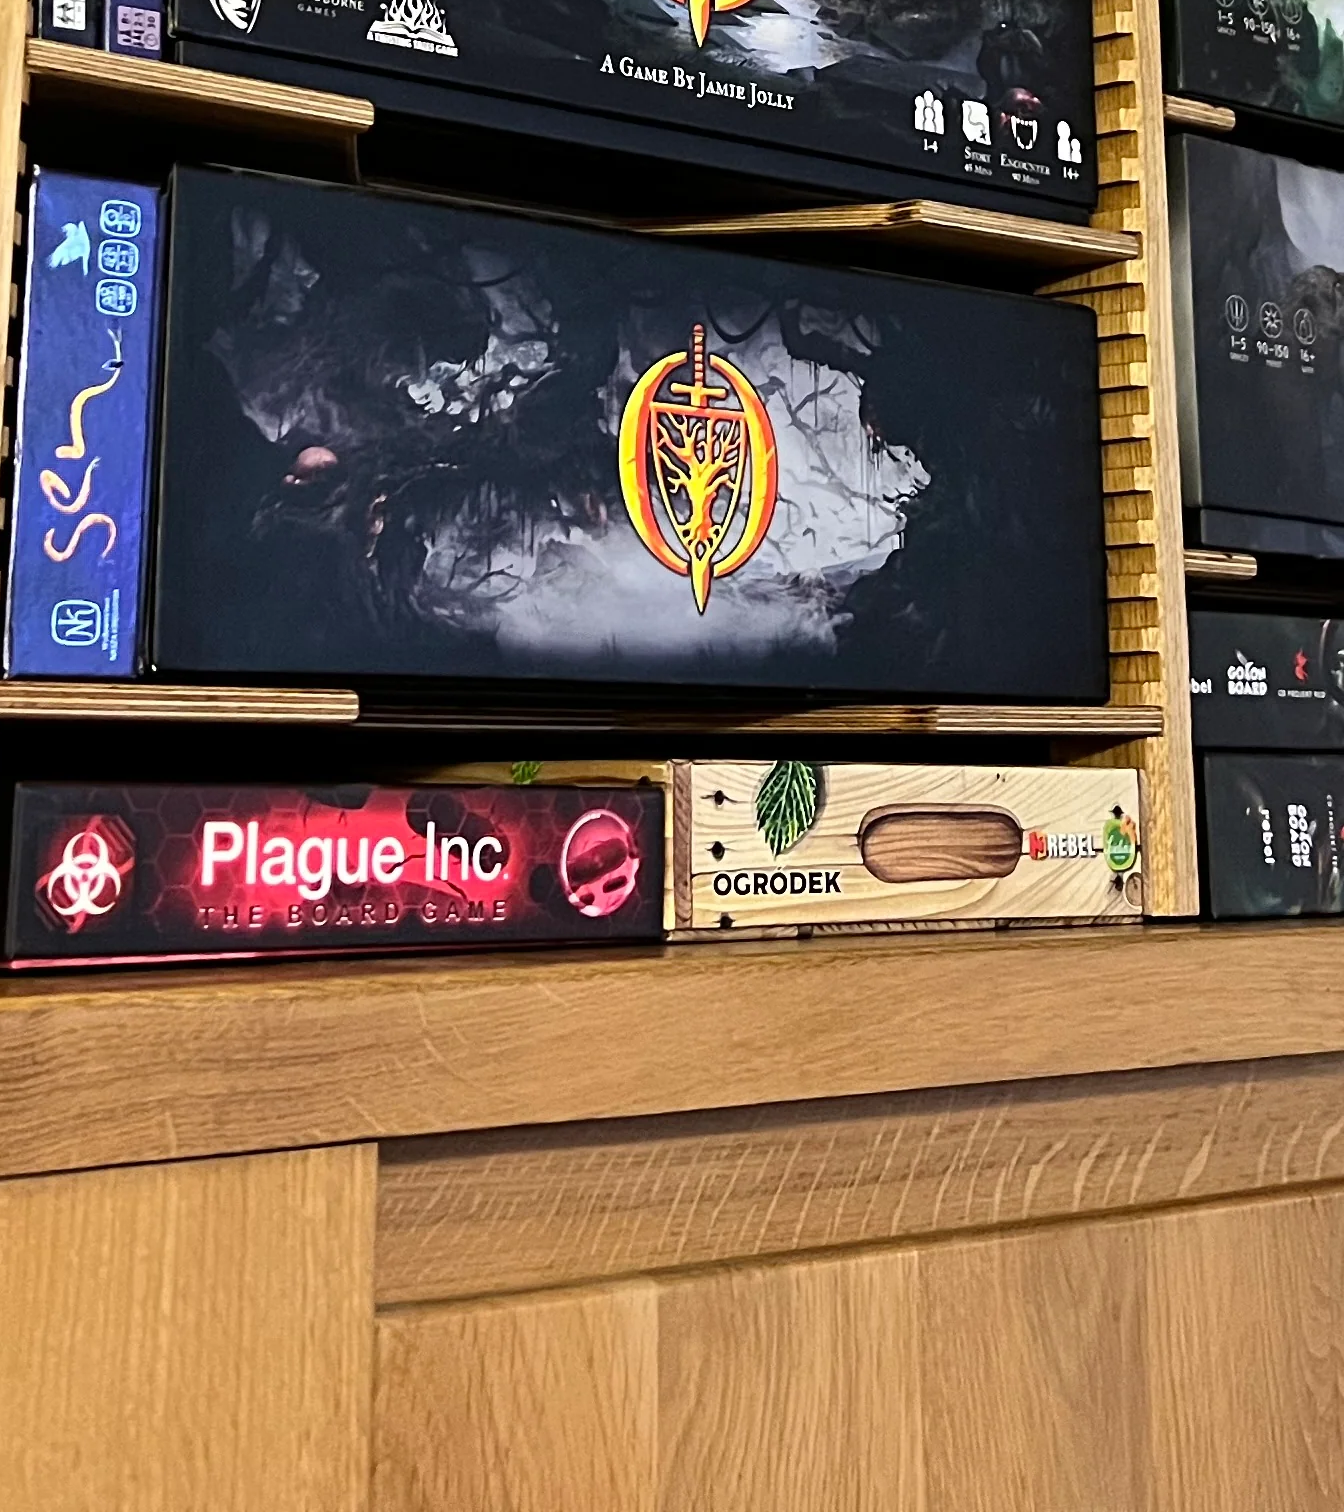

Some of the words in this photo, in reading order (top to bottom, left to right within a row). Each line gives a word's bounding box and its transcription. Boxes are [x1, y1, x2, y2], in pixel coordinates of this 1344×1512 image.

[296, 2, 337, 18] GAMES
[1217, 9, 1234, 25] 1-5
[599, 53, 615, 74] A
[923, 138, 939, 154] 1-4
[1063, 166, 1080, 180] 14+
[1230, 334, 1247, 351] 1-5
[1256, 340, 1290, 359] 90-150
[1190, 677, 1213, 694] bel
[1227, 680, 1268, 696] BOARD
[1047, 832, 1097, 858] REBEL
[1260, 808, 1276, 864] rebel
[1287, 803, 1302, 868] BOARD
[199, 819, 409, 903] Plague
[425, 820, 511, 883] Inc.
[712, 865, 842, 897] OGRÓDEK
[197, 906, 265, 929] THE
[286, 902, 400, 927] BOARD
[419, 898, 509, 923] GAME
